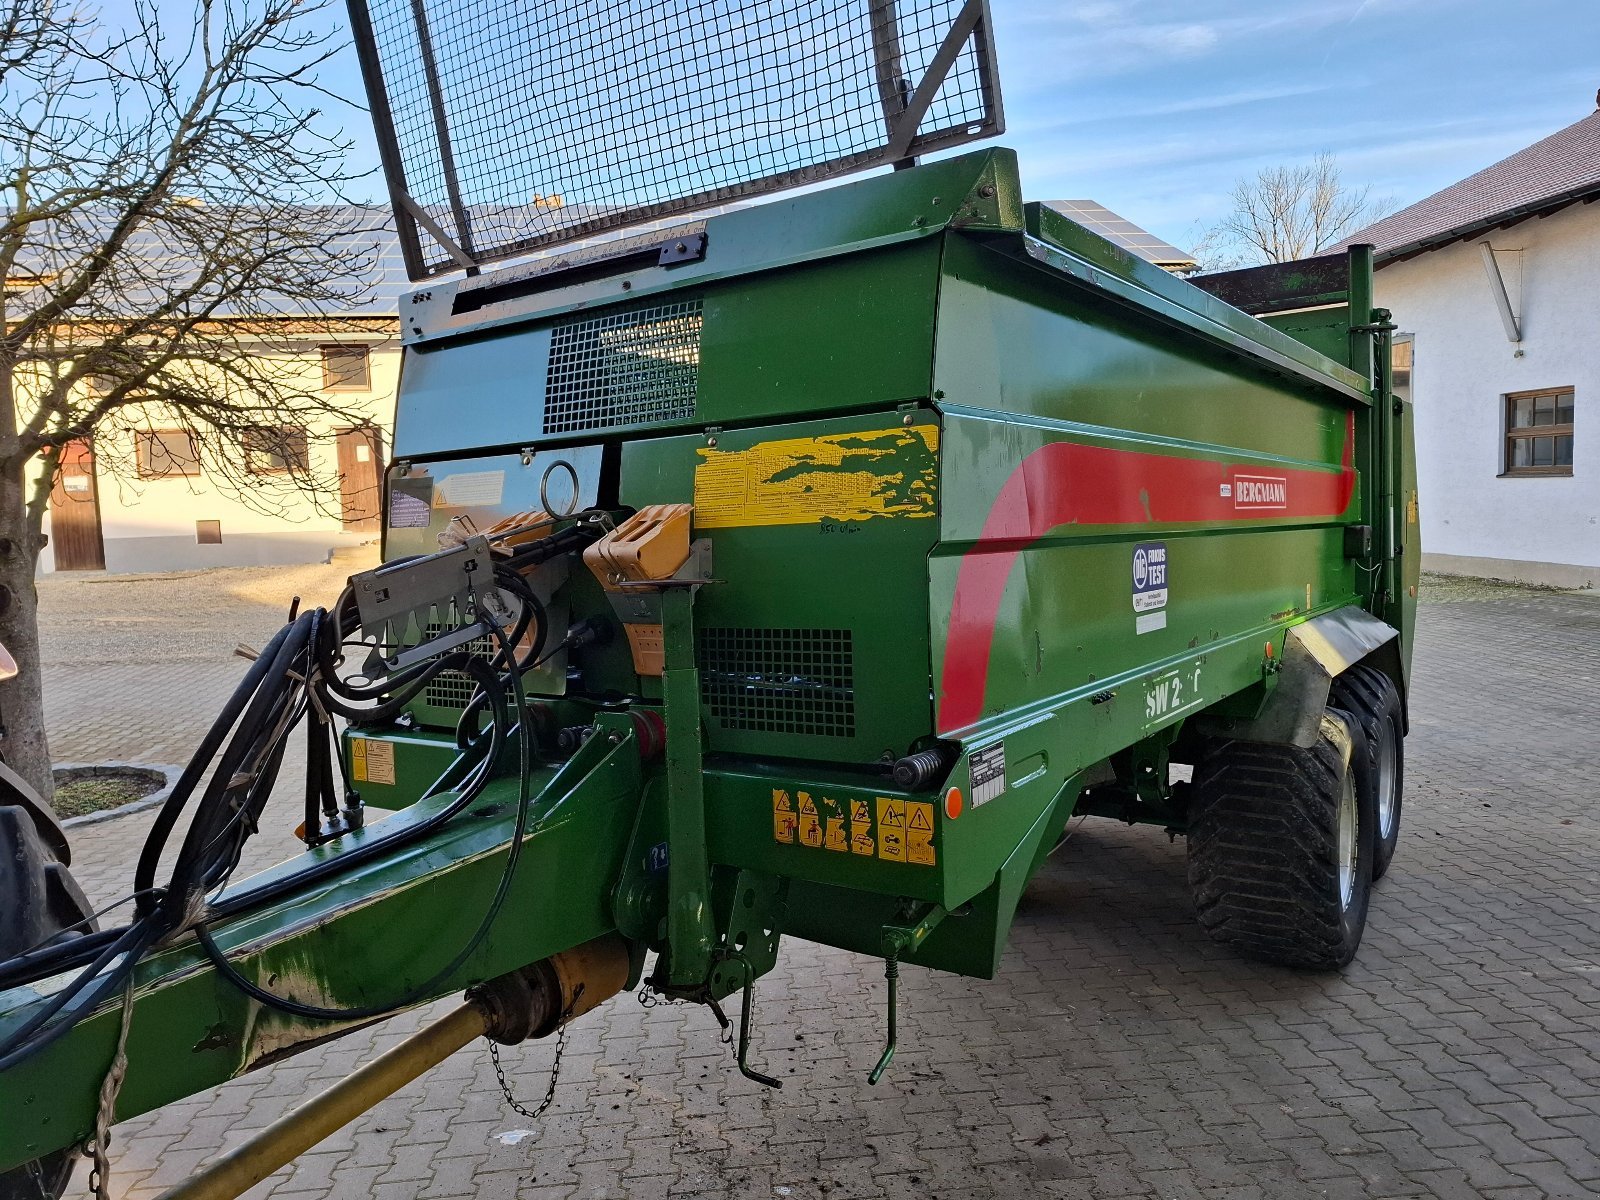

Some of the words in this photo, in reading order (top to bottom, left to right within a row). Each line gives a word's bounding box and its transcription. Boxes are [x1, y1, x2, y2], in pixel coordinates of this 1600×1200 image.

[1236, 481, 1285, 503] BERGMANN
[1147, 548, 1166, 563] FOKUS
[1148, 564, 1166, 586] TEST
[1144, 681, 1169, 718] SW
